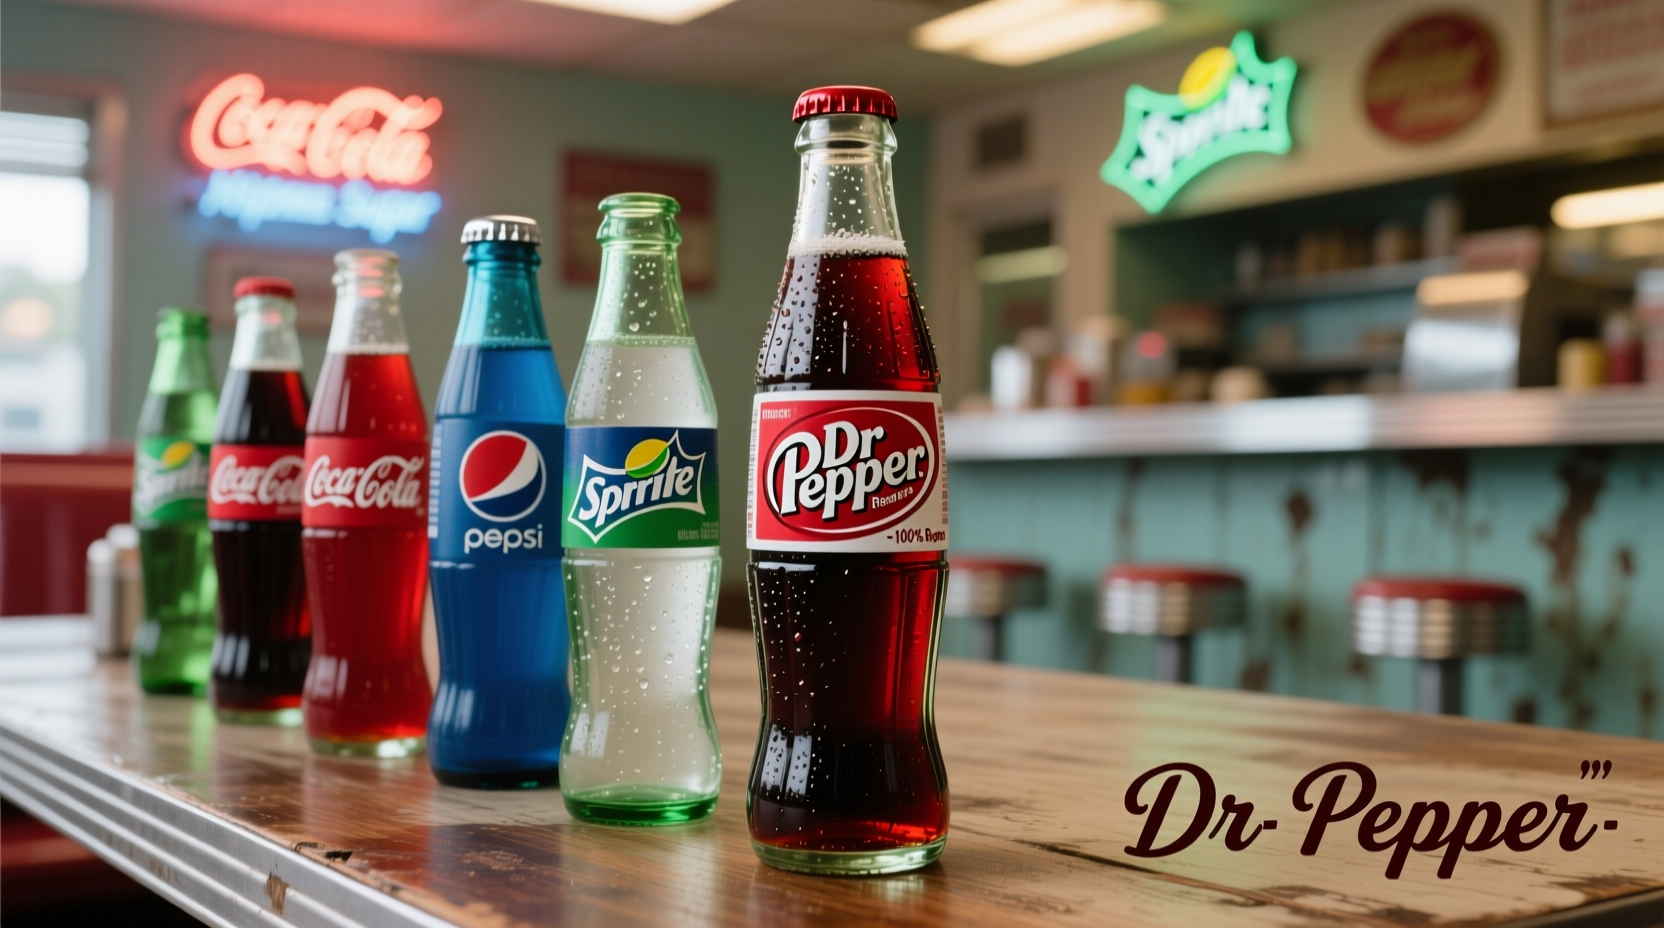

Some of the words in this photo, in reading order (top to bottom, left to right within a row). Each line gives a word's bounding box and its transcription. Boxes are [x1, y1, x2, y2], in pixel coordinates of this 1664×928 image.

[822, 420, 885, 469] Dr
[304, 455, 425, 509] Coca-Cola
[464, 523, 543, 554] pepsi
